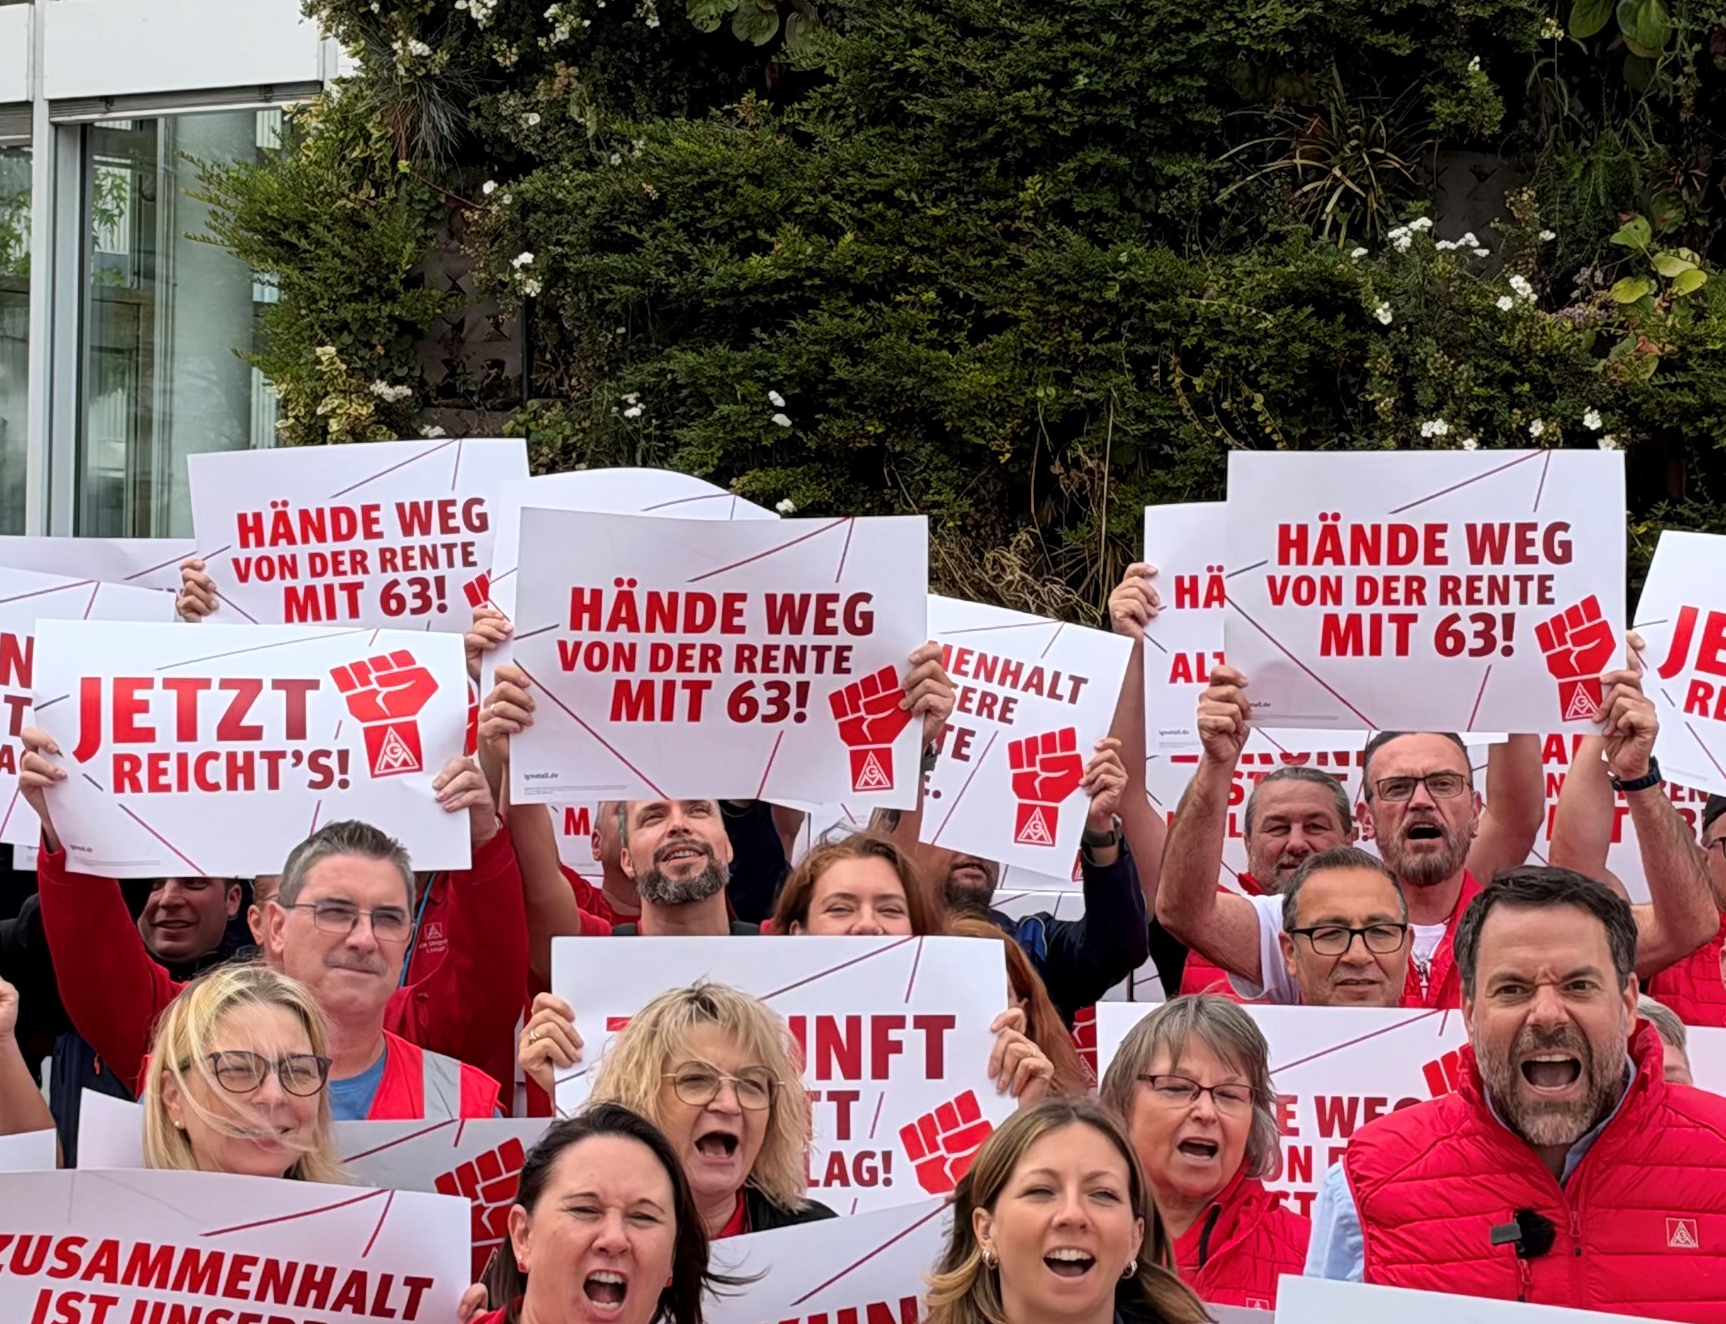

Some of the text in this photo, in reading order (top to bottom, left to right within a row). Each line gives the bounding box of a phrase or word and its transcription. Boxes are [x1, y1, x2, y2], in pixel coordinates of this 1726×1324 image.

[238, 499, 487, 548] HÄNDE WEG
[1278, 513, 1571, 565] HÄNDE WEG
[233, 543, 473, 582] VON DER RENTE
[285, 577, 446, 622] MIT 63!
[570, 578, 873, 635] HÄNDE WEG
[1268, 575, 1552, 606] VON DER RENTE
[558, 640, 851, 674] VON DER RENTE
[1321, 613, 1514, 657] MIT 63!
[73, 678, 317, 764] JETZT
[610, 680, 809, 723] MIT 63!
[114, 751, 348, 793] REICHT'S!
